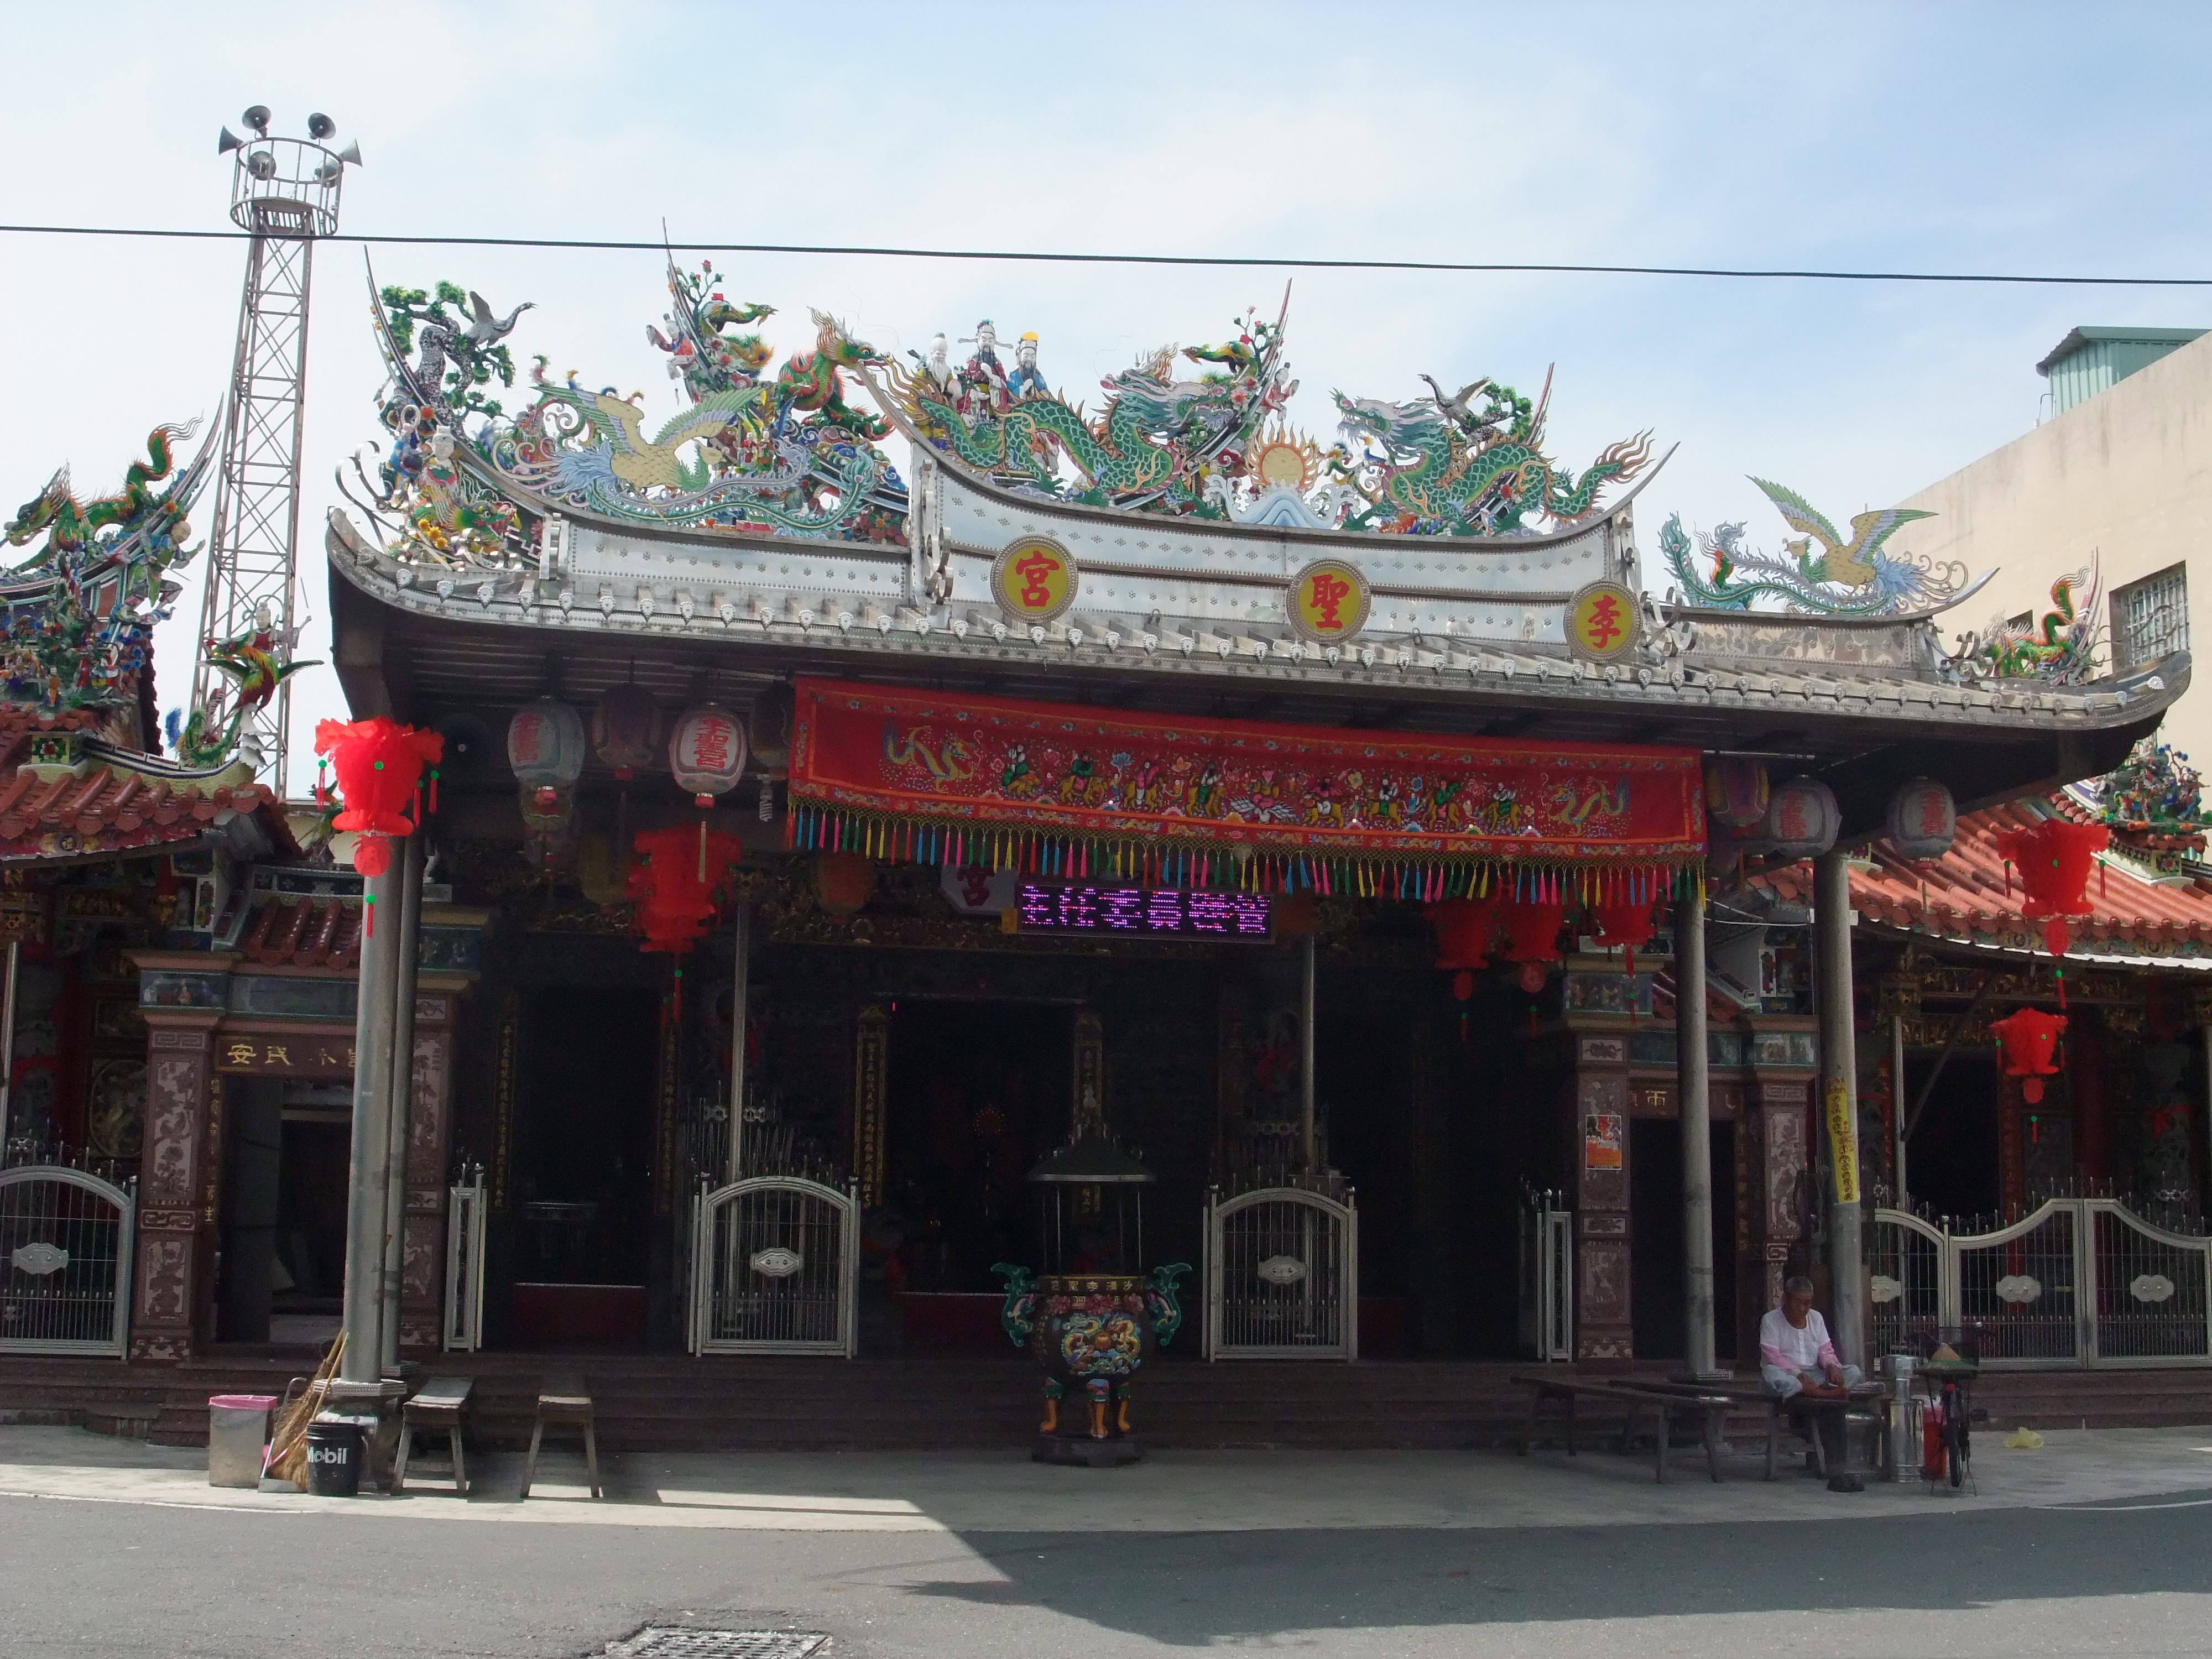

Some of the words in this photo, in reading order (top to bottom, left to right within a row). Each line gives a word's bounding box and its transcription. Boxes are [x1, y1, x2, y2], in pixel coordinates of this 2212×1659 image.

[1015, 550, 1060, 607] 宮
[1310, 573, 1350, 629] 聖
[1588, 594, 1621, 649] 李
[307, 1446, 349, 1464] Mobil
